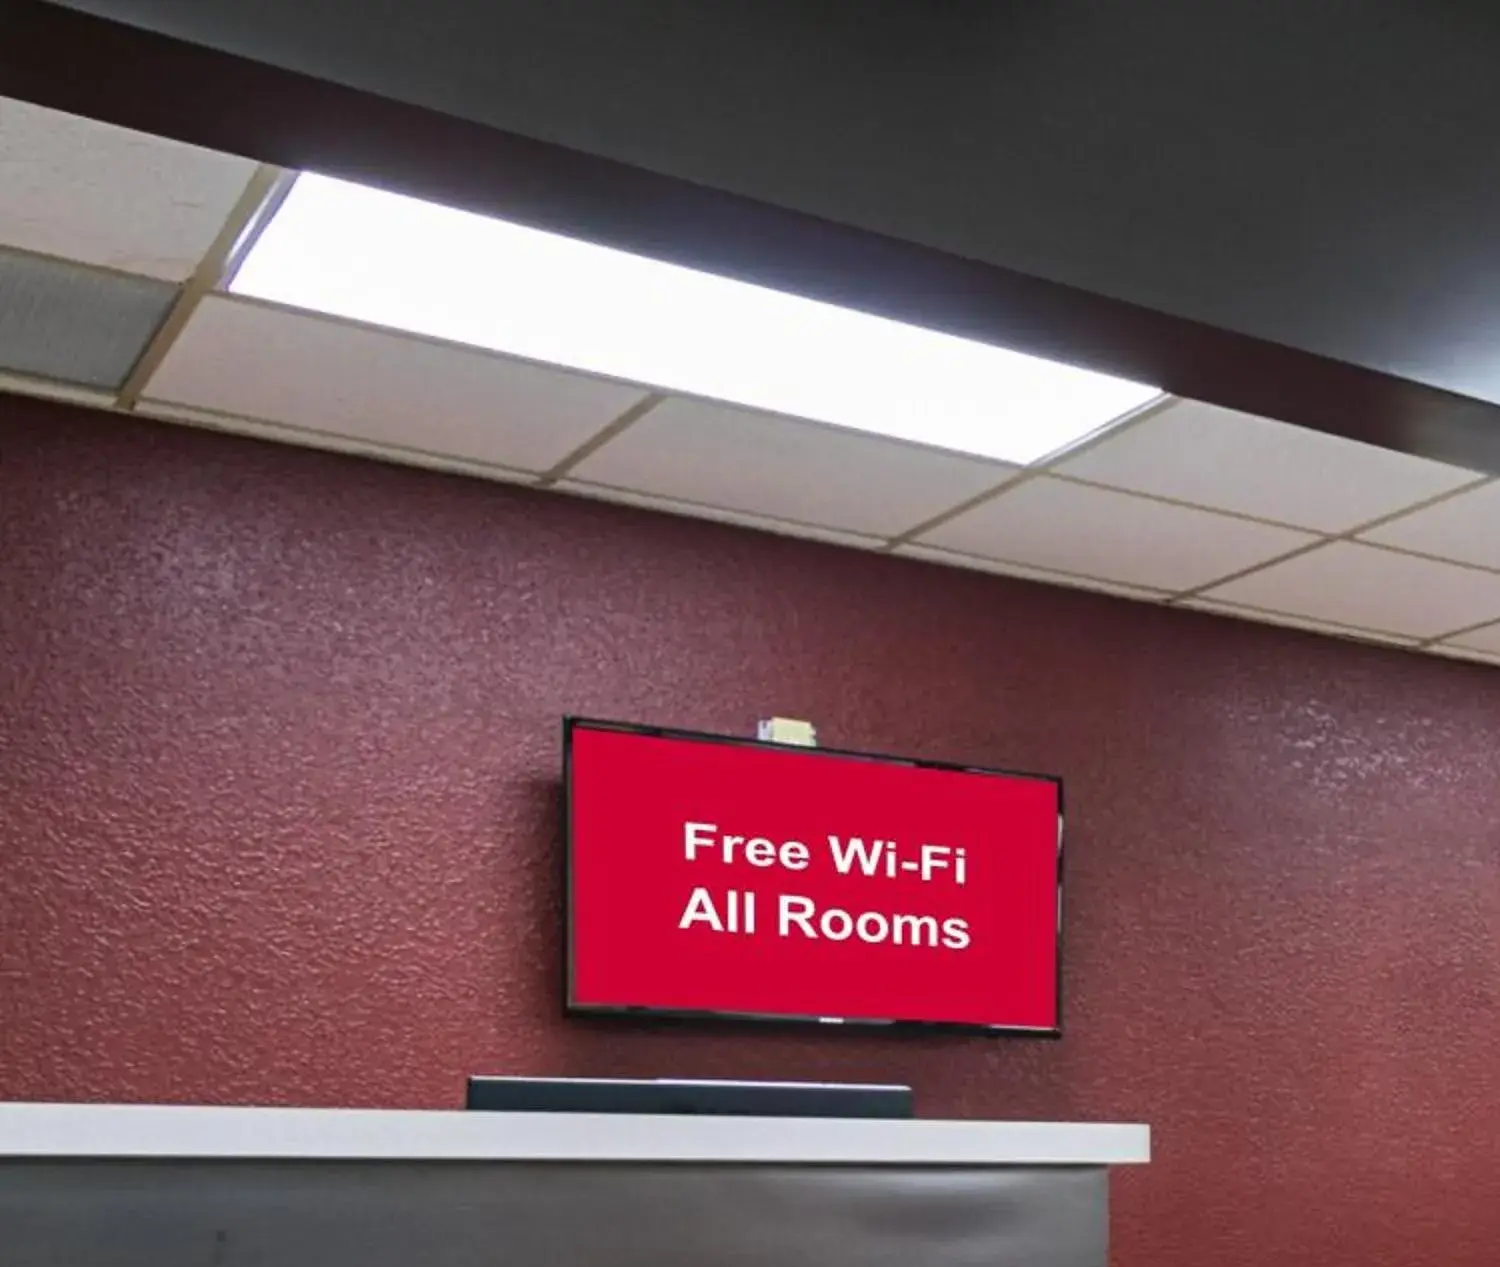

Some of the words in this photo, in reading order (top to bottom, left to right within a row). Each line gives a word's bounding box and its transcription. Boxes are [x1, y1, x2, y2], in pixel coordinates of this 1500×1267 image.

[684, 822, 810, 870] Free
[828, 835, 966, 885] Wi-Fi
[678, 887, 756, 934] All
[779, 894, 971, 950] Rooms
